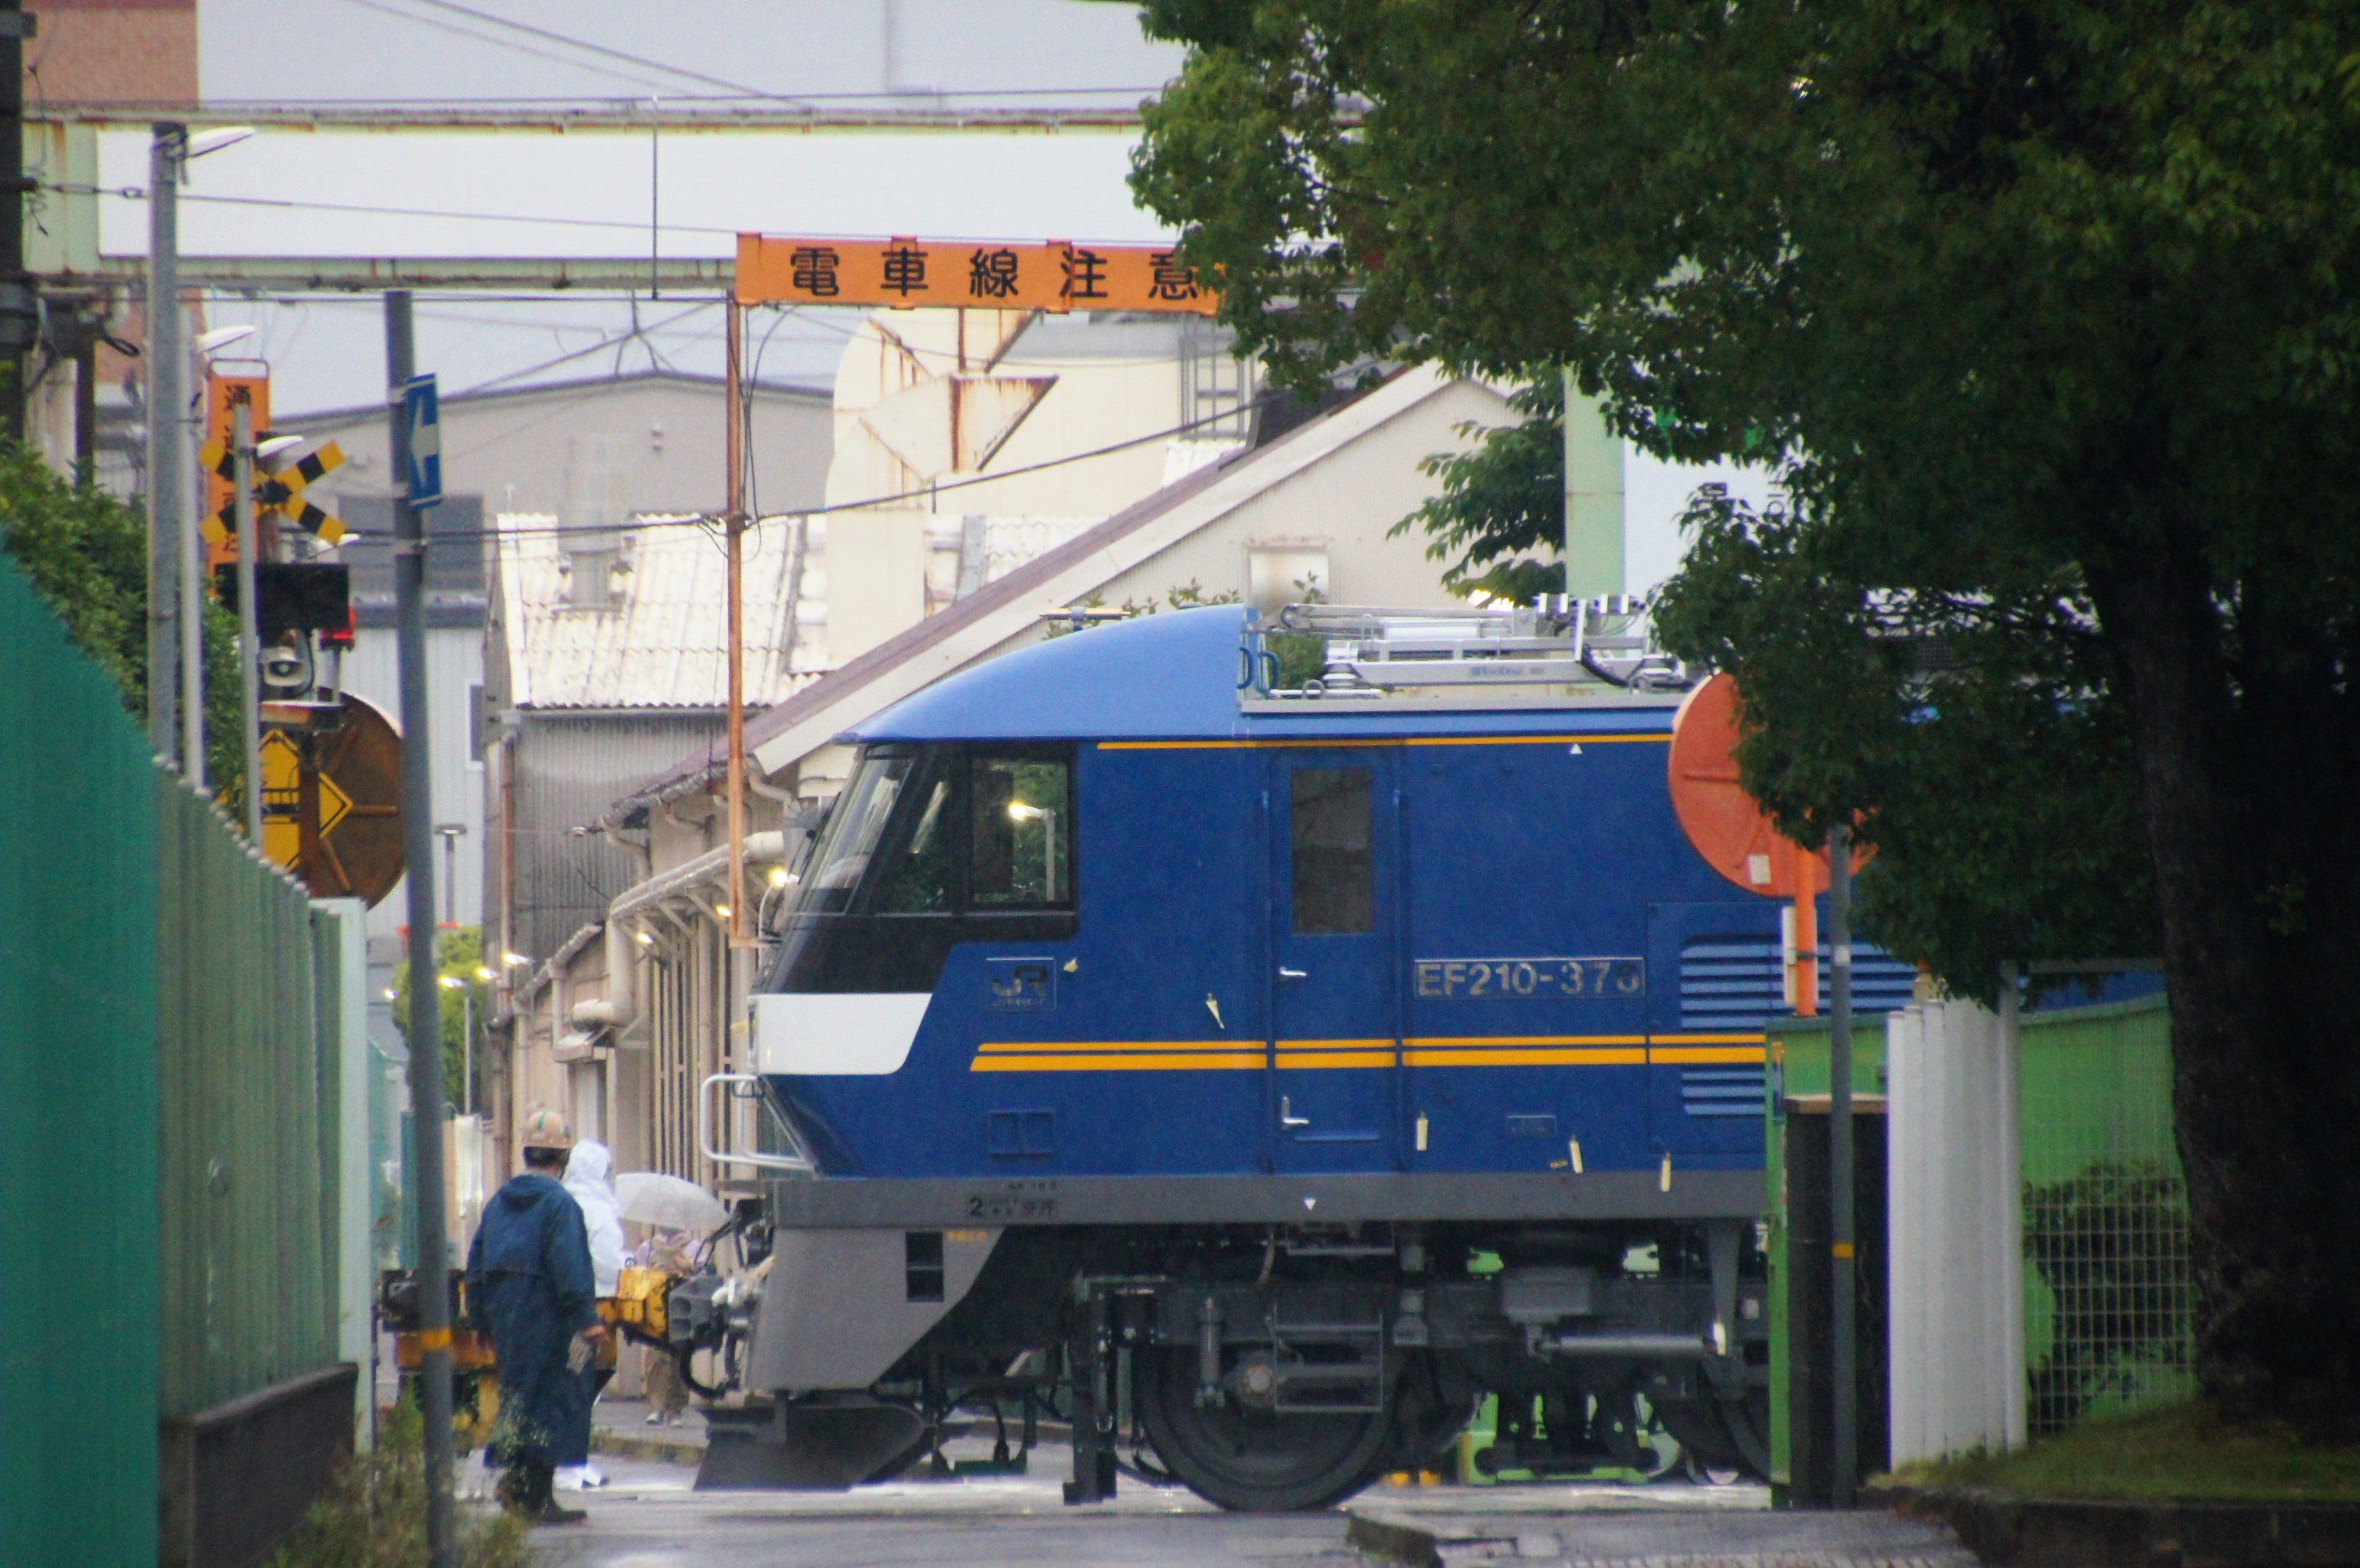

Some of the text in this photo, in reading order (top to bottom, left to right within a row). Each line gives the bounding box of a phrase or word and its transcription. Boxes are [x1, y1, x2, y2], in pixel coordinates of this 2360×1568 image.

[790, 246, 1198, 299] 電車線注意
[991, 964, 1048, 997] JR
